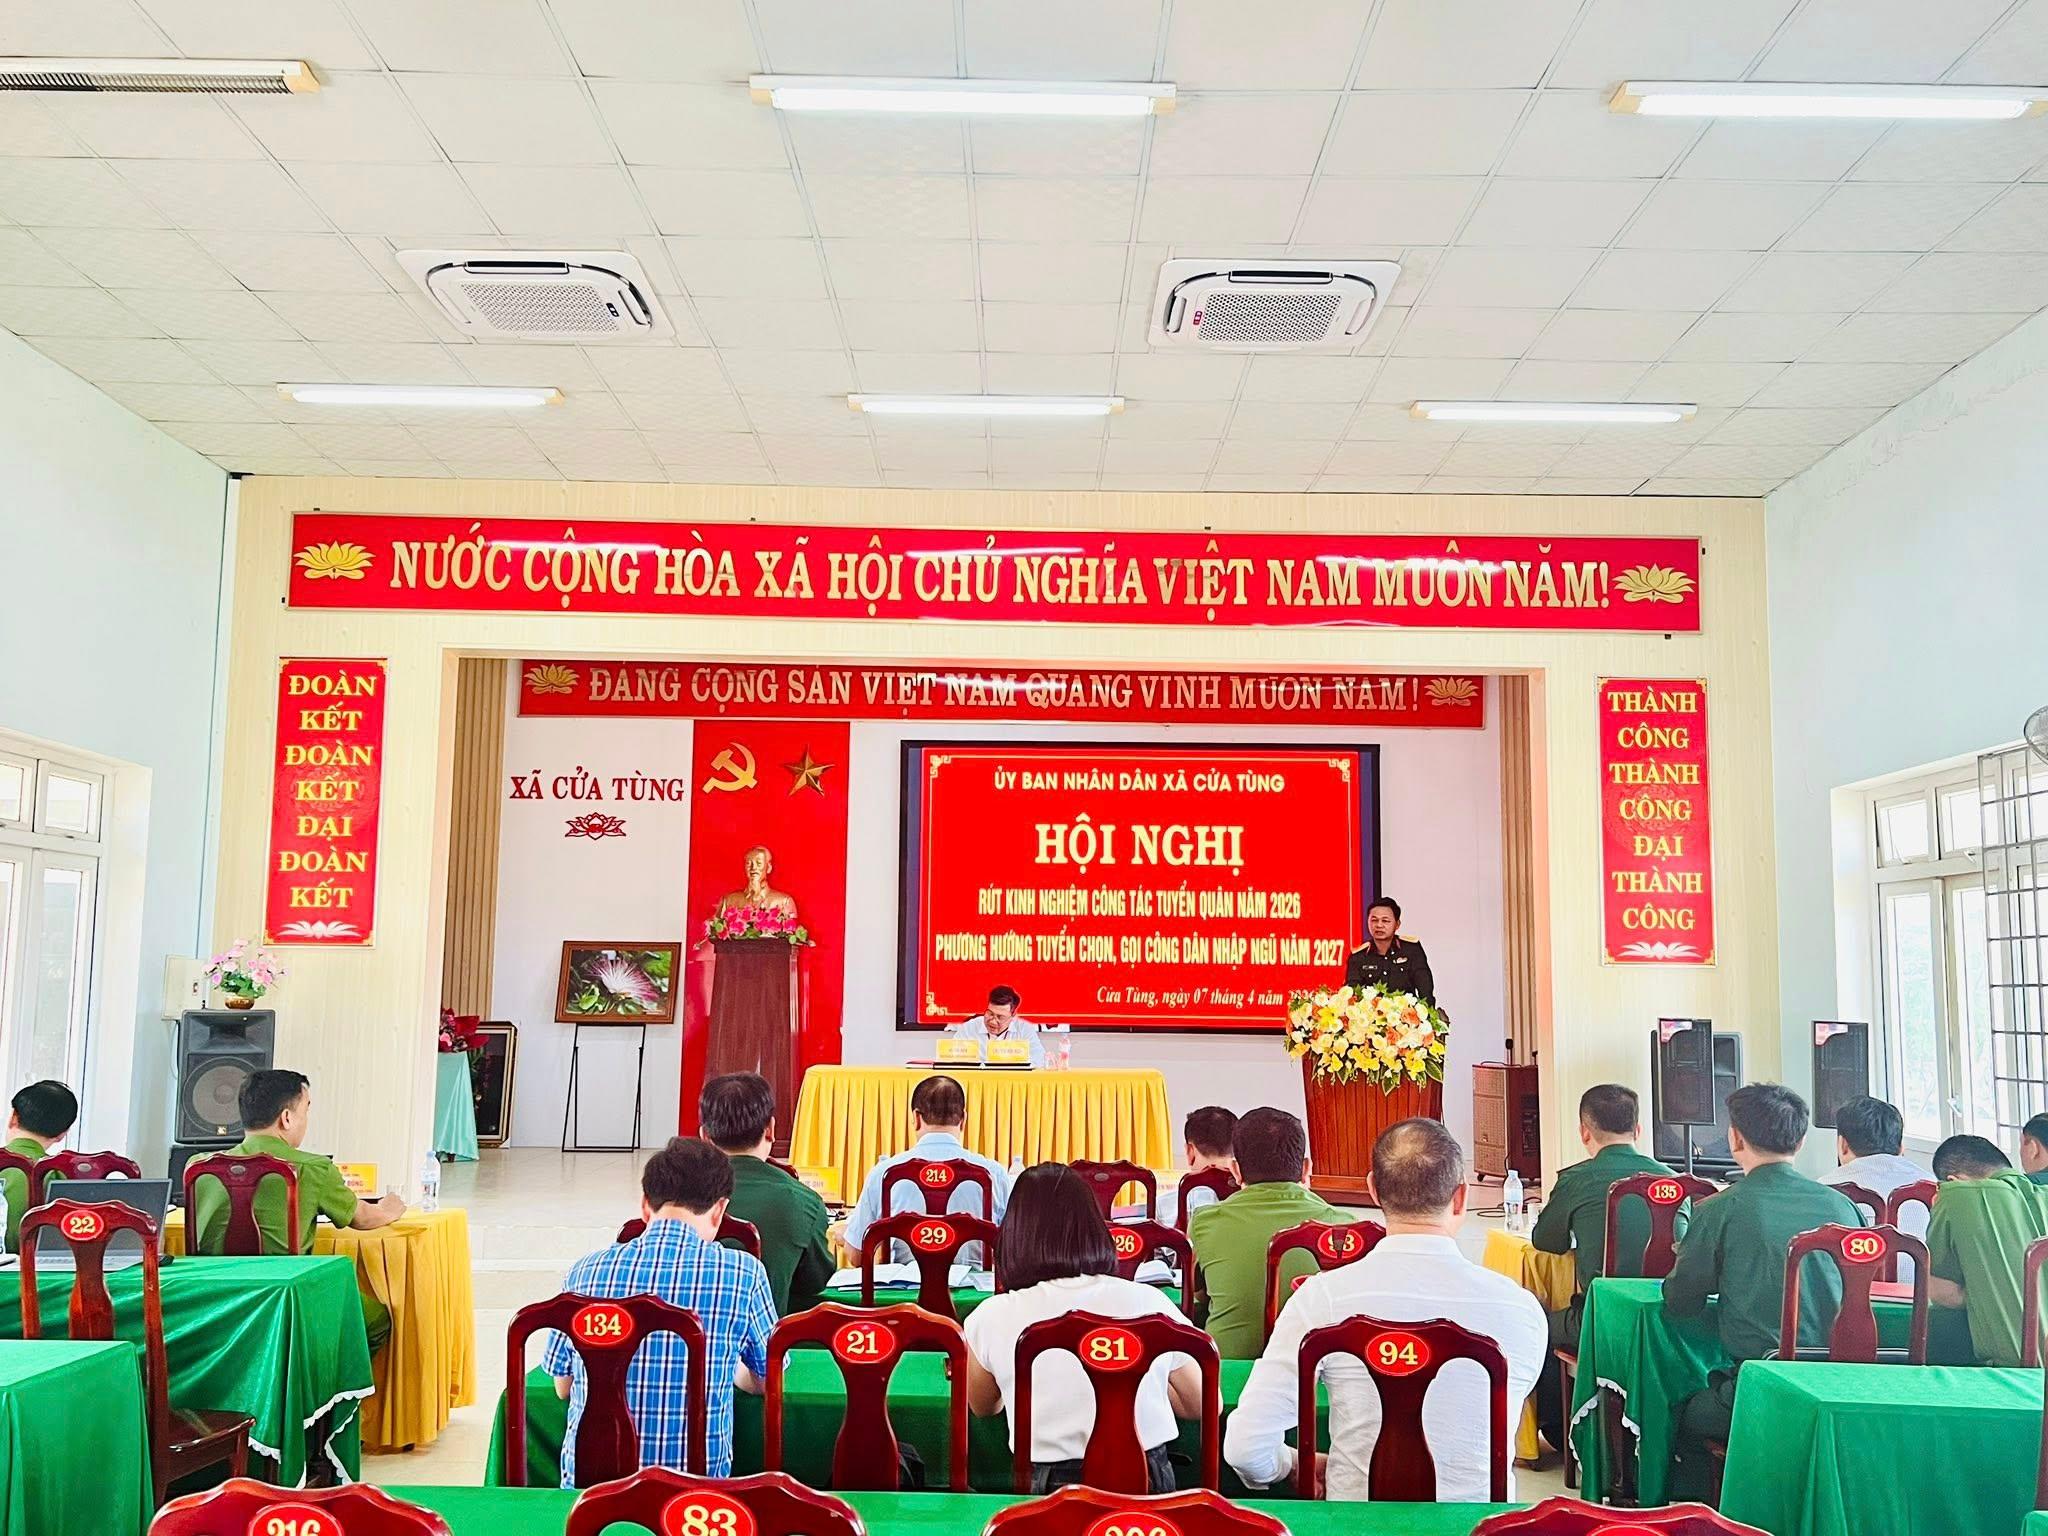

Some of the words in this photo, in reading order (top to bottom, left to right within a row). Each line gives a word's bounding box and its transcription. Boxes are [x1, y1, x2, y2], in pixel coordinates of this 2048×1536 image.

[390, 522, 512, 591] NƯỚC
[523, 527, 641, 608] CỘNG
[653, 530, 741, 597] HÒA
[753, 536, 814, 599] XÃ
[827, 534, 904, 617] HỘI
[913, 534, 1003, 603] CHỦ
[1013, 540, 1148, 605] NGHĨA
[1153, 539, 1254, 621] VIỆT
[1266, 559, 1362, 606] NAM
[1372, 539, 1496, 607] MUÔN
[1500, 543, 1610, 609] NĂM!
[288, 669, 377, 696] ĐOÀN
[944, 672, 1017, 707] NAM
[1025, 673, 1133, 710] QUANG
[1138, 674, 1221, 710] VINH
[1607, 686, 1697, 713] THÀNH
[299, 701, 362, 731] KẾT
[1617, 722, 1690, 749] CÔNG
[284, 740, 374, 767] ĐOÀN
[509, 769, 544, 799] XÃ
[552, 766, 603, 800] CỬA
[612, 770, 685, 801] TÙNG
[994, 766, 1017, 790] ỦY
[1021, 771, 1058, 790] BAN
[1063, 768, 1115, 791] NHÂN
[1119, 768, 1157, 791] DÂN
[1162, 769, 1188, 791] XÃ
[1193, 768, 1232, 792] CỬA
[1236, 770, 1285, 793] TÙNG
[1609, 758, 1700, 785] THÀNH
[295, 771, 359, 801] KẾT
[1619, 795, 1691, 821] CÔNG
[296, 816, 352, 841] ĐẠI
[1034, 812, 1116, 874] HỘI
[1131, 824, 1244, 876] NGHỊ
[1633, 835, 1683, 862] ĐẠI
[279, 845, 368, 873] ĐOÀN
[289, 877, 353, 908] KẾT
[1611, 866, 1703, 894] THÀNH
[978, 883, 1003, 915] RÚT
[1005, 888, 1035, 915] KINH
[1039, 883, 1088, 921] NGHIỆM
[1091, 884, 1126, 917] CÔNG
[1129, 885, 1153, 917] TÁC
[1155, 880, 1195, 918] TUYỂN
[1199, 886, 1234, 920] QUÂN
[1237, 886, 1267, 919] NĂM
[1270, 892, 1301, 919] 2026
[1622, 903, 1695, 930] CÔNG
[935, 931, 987, 961] PHƯƠNG
[989, 929, 1033, 962] HƯỚNG
[1036, 924, 1075, 963] TUYỂN
[1078, 935, 1117, 968] CHỌN,
[1120, 936, 1141, 968] GỌI
[1145, 930, 1179, 964] CÔNG
[1183, 931, 1209, 964] DÂN
[1212, 931, 1247, 970] NHẬP
[1250, 933, 1277, 965] NGŨ
[1280, 933, 1310, 966] NĂM
[1313, 939, 1344, 966] 2027
[1162, 988, 1190, 1009] ngày
[1193, 987, 1209, 1004] 07
[1210, 988, 1244, 1009] tháng
[1247, 989, 1255, 1004] 4
[1258, 989, 1283, 1005] năm
[926, 1168, 947, 1183] 214
[1654, 1184, 1677, 1199] 135
[69, 1215, 96, 1234] 22
[920, 1226, 947, 1244] 29
[1111, 1234, 1135, 1252] 26
[1850, 1237, 1878, 1255] 80
[583, 1313, 622, 1337] 134
[846, 1329, 879, 1355] 21
[1089, 1336, 1130, 1361] 81
[1379, 1341, 1418, 1365] 94
[681, 1504, 738, 1536] 83
